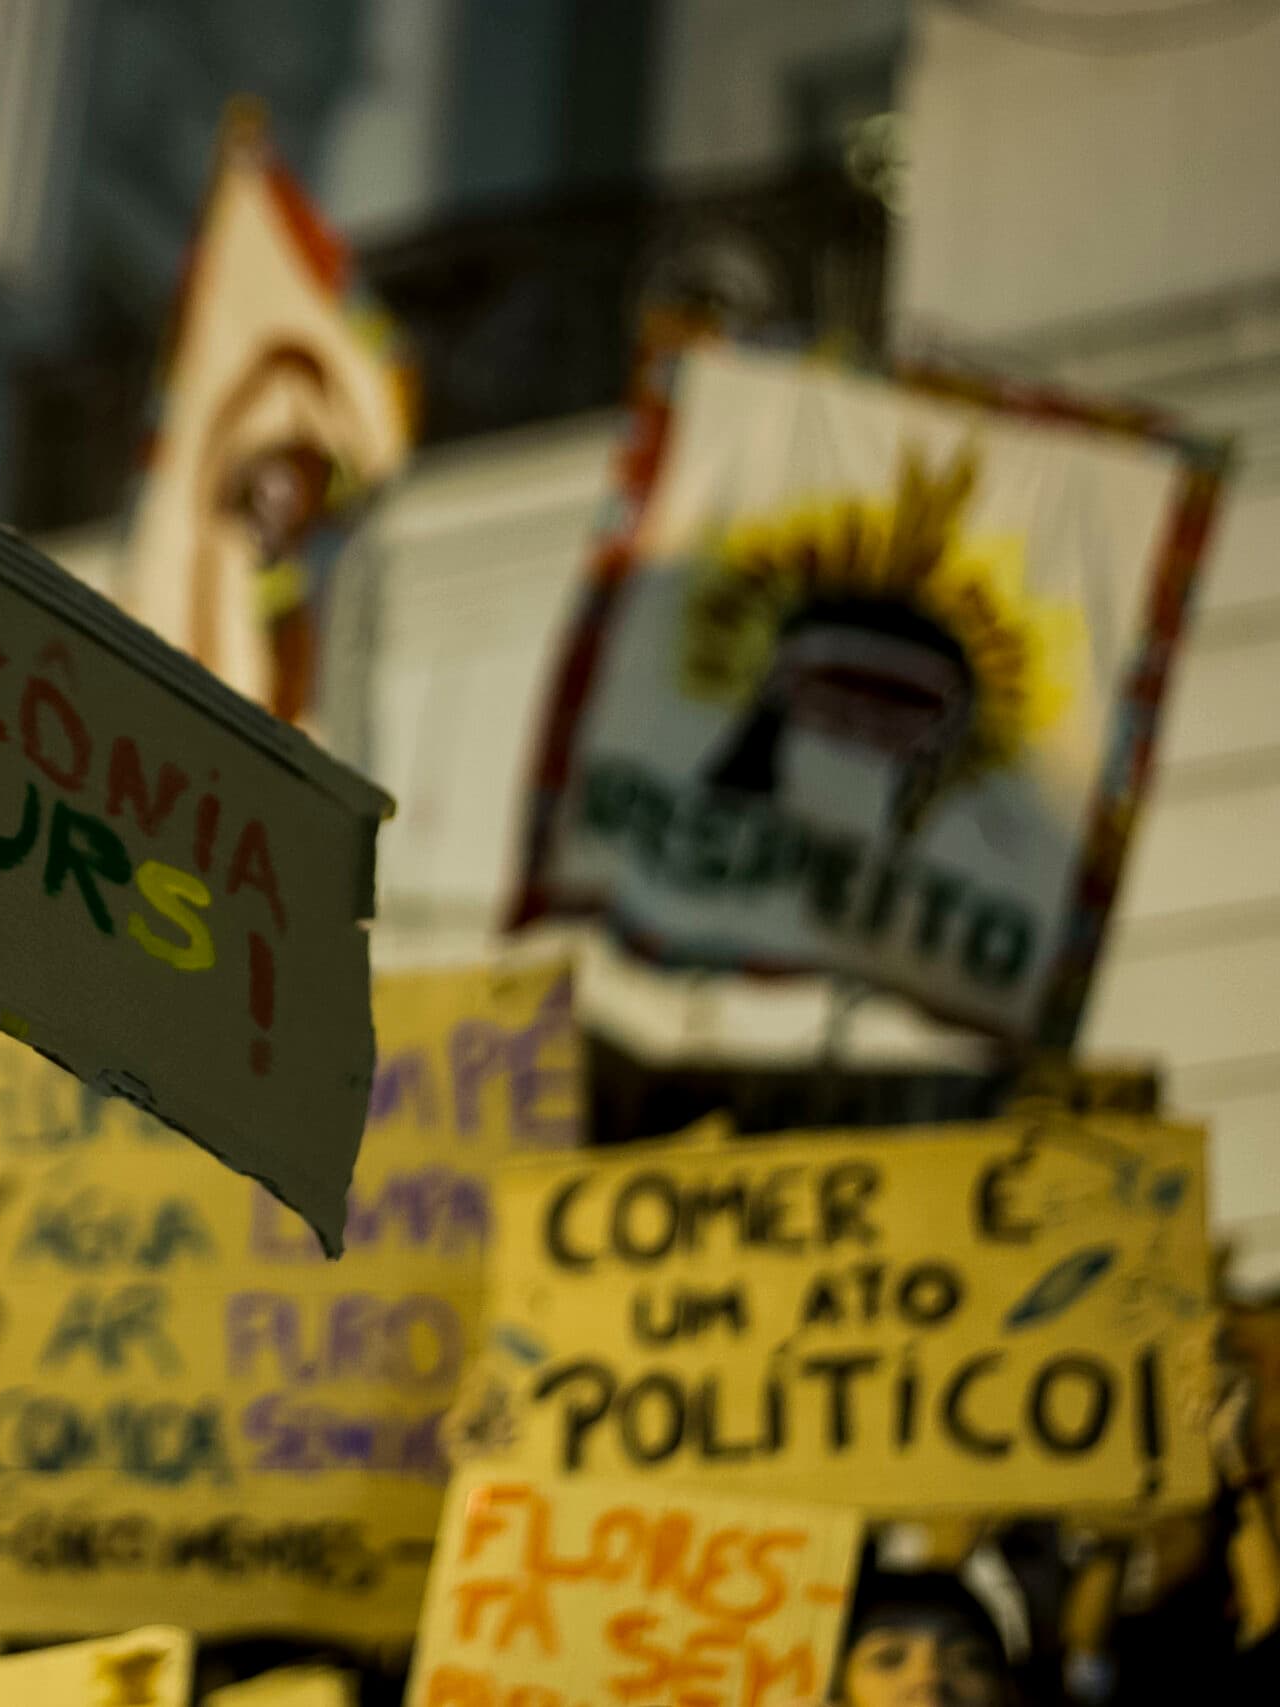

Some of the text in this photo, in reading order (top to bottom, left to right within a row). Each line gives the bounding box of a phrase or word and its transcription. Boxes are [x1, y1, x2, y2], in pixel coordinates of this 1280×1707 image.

[544, 1164, 884, 1271] COMER
[632, 1262, 965, 1346] UM ATO
